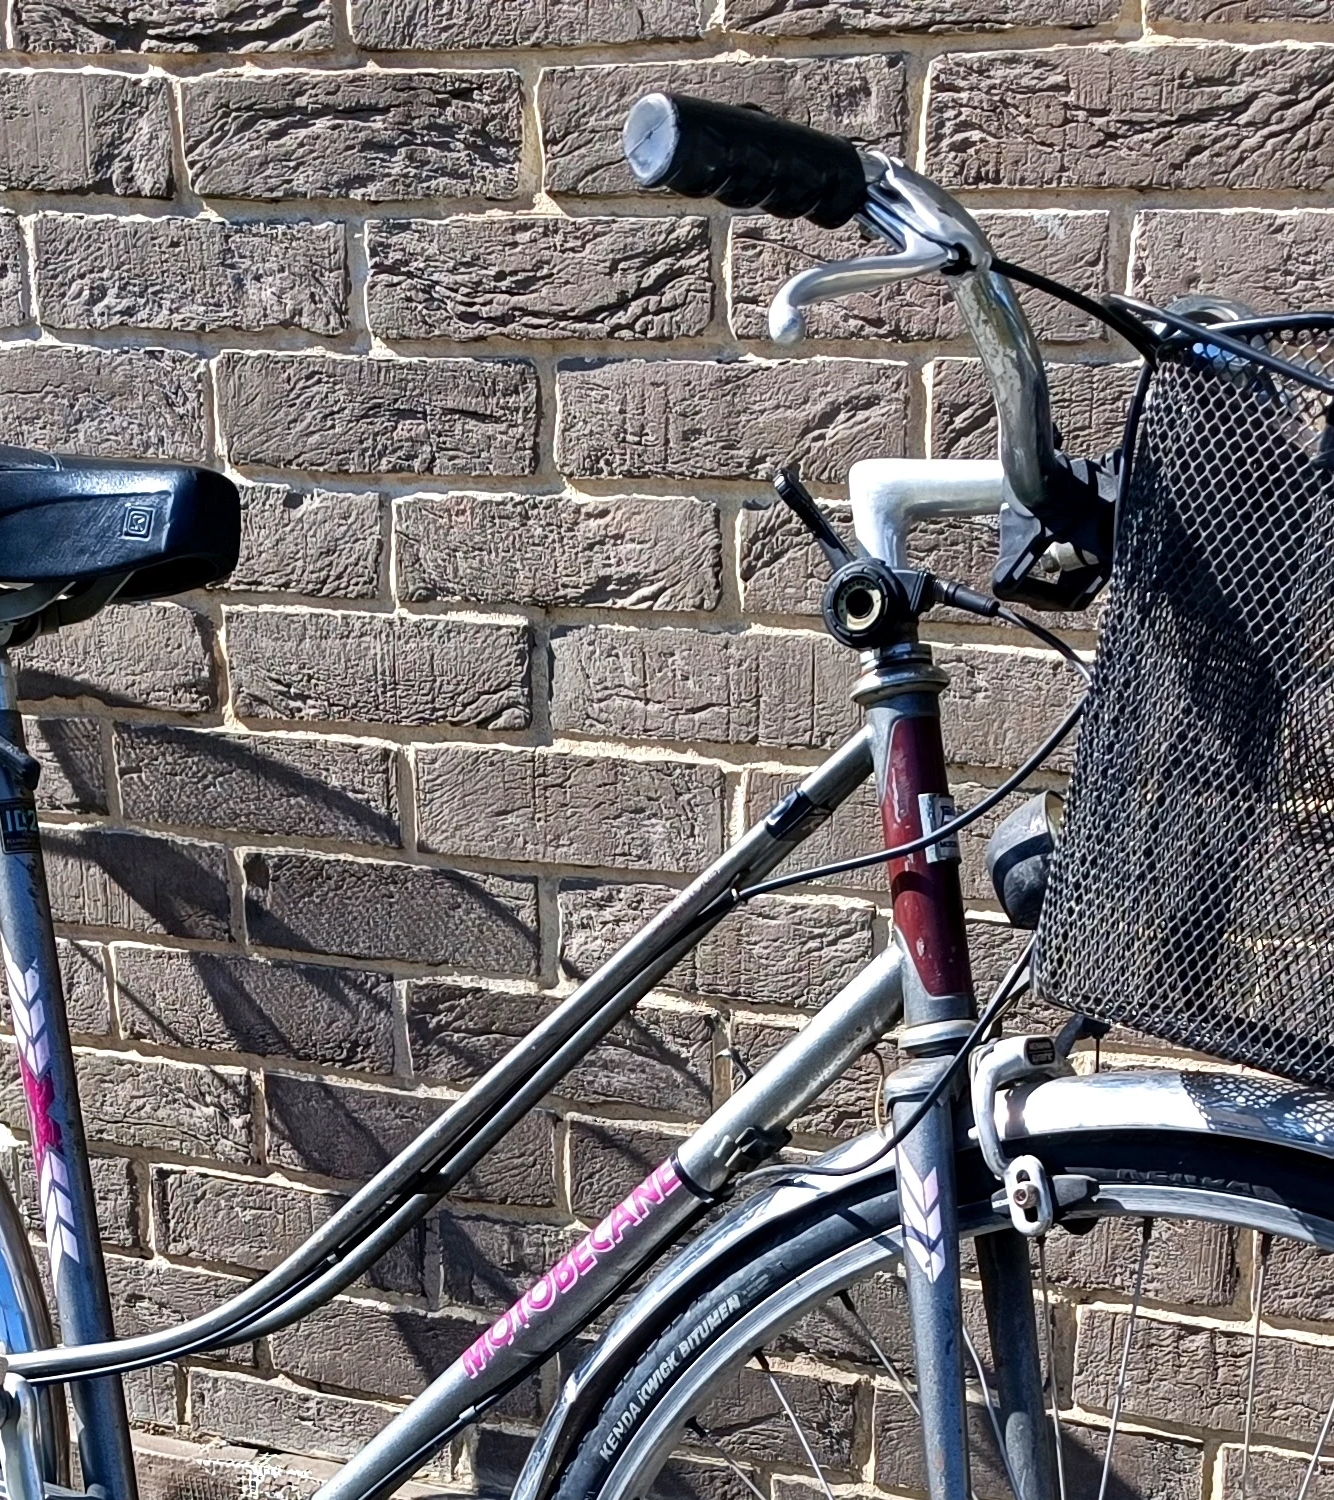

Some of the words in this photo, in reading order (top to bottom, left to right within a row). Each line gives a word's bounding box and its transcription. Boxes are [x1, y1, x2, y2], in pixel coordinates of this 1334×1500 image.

[463, 1159, 684, 1379] MOTOBECANE
[599, 1402, 640, 1463] KENDA
[678, 1293, 742, 1358] BITUMEN
